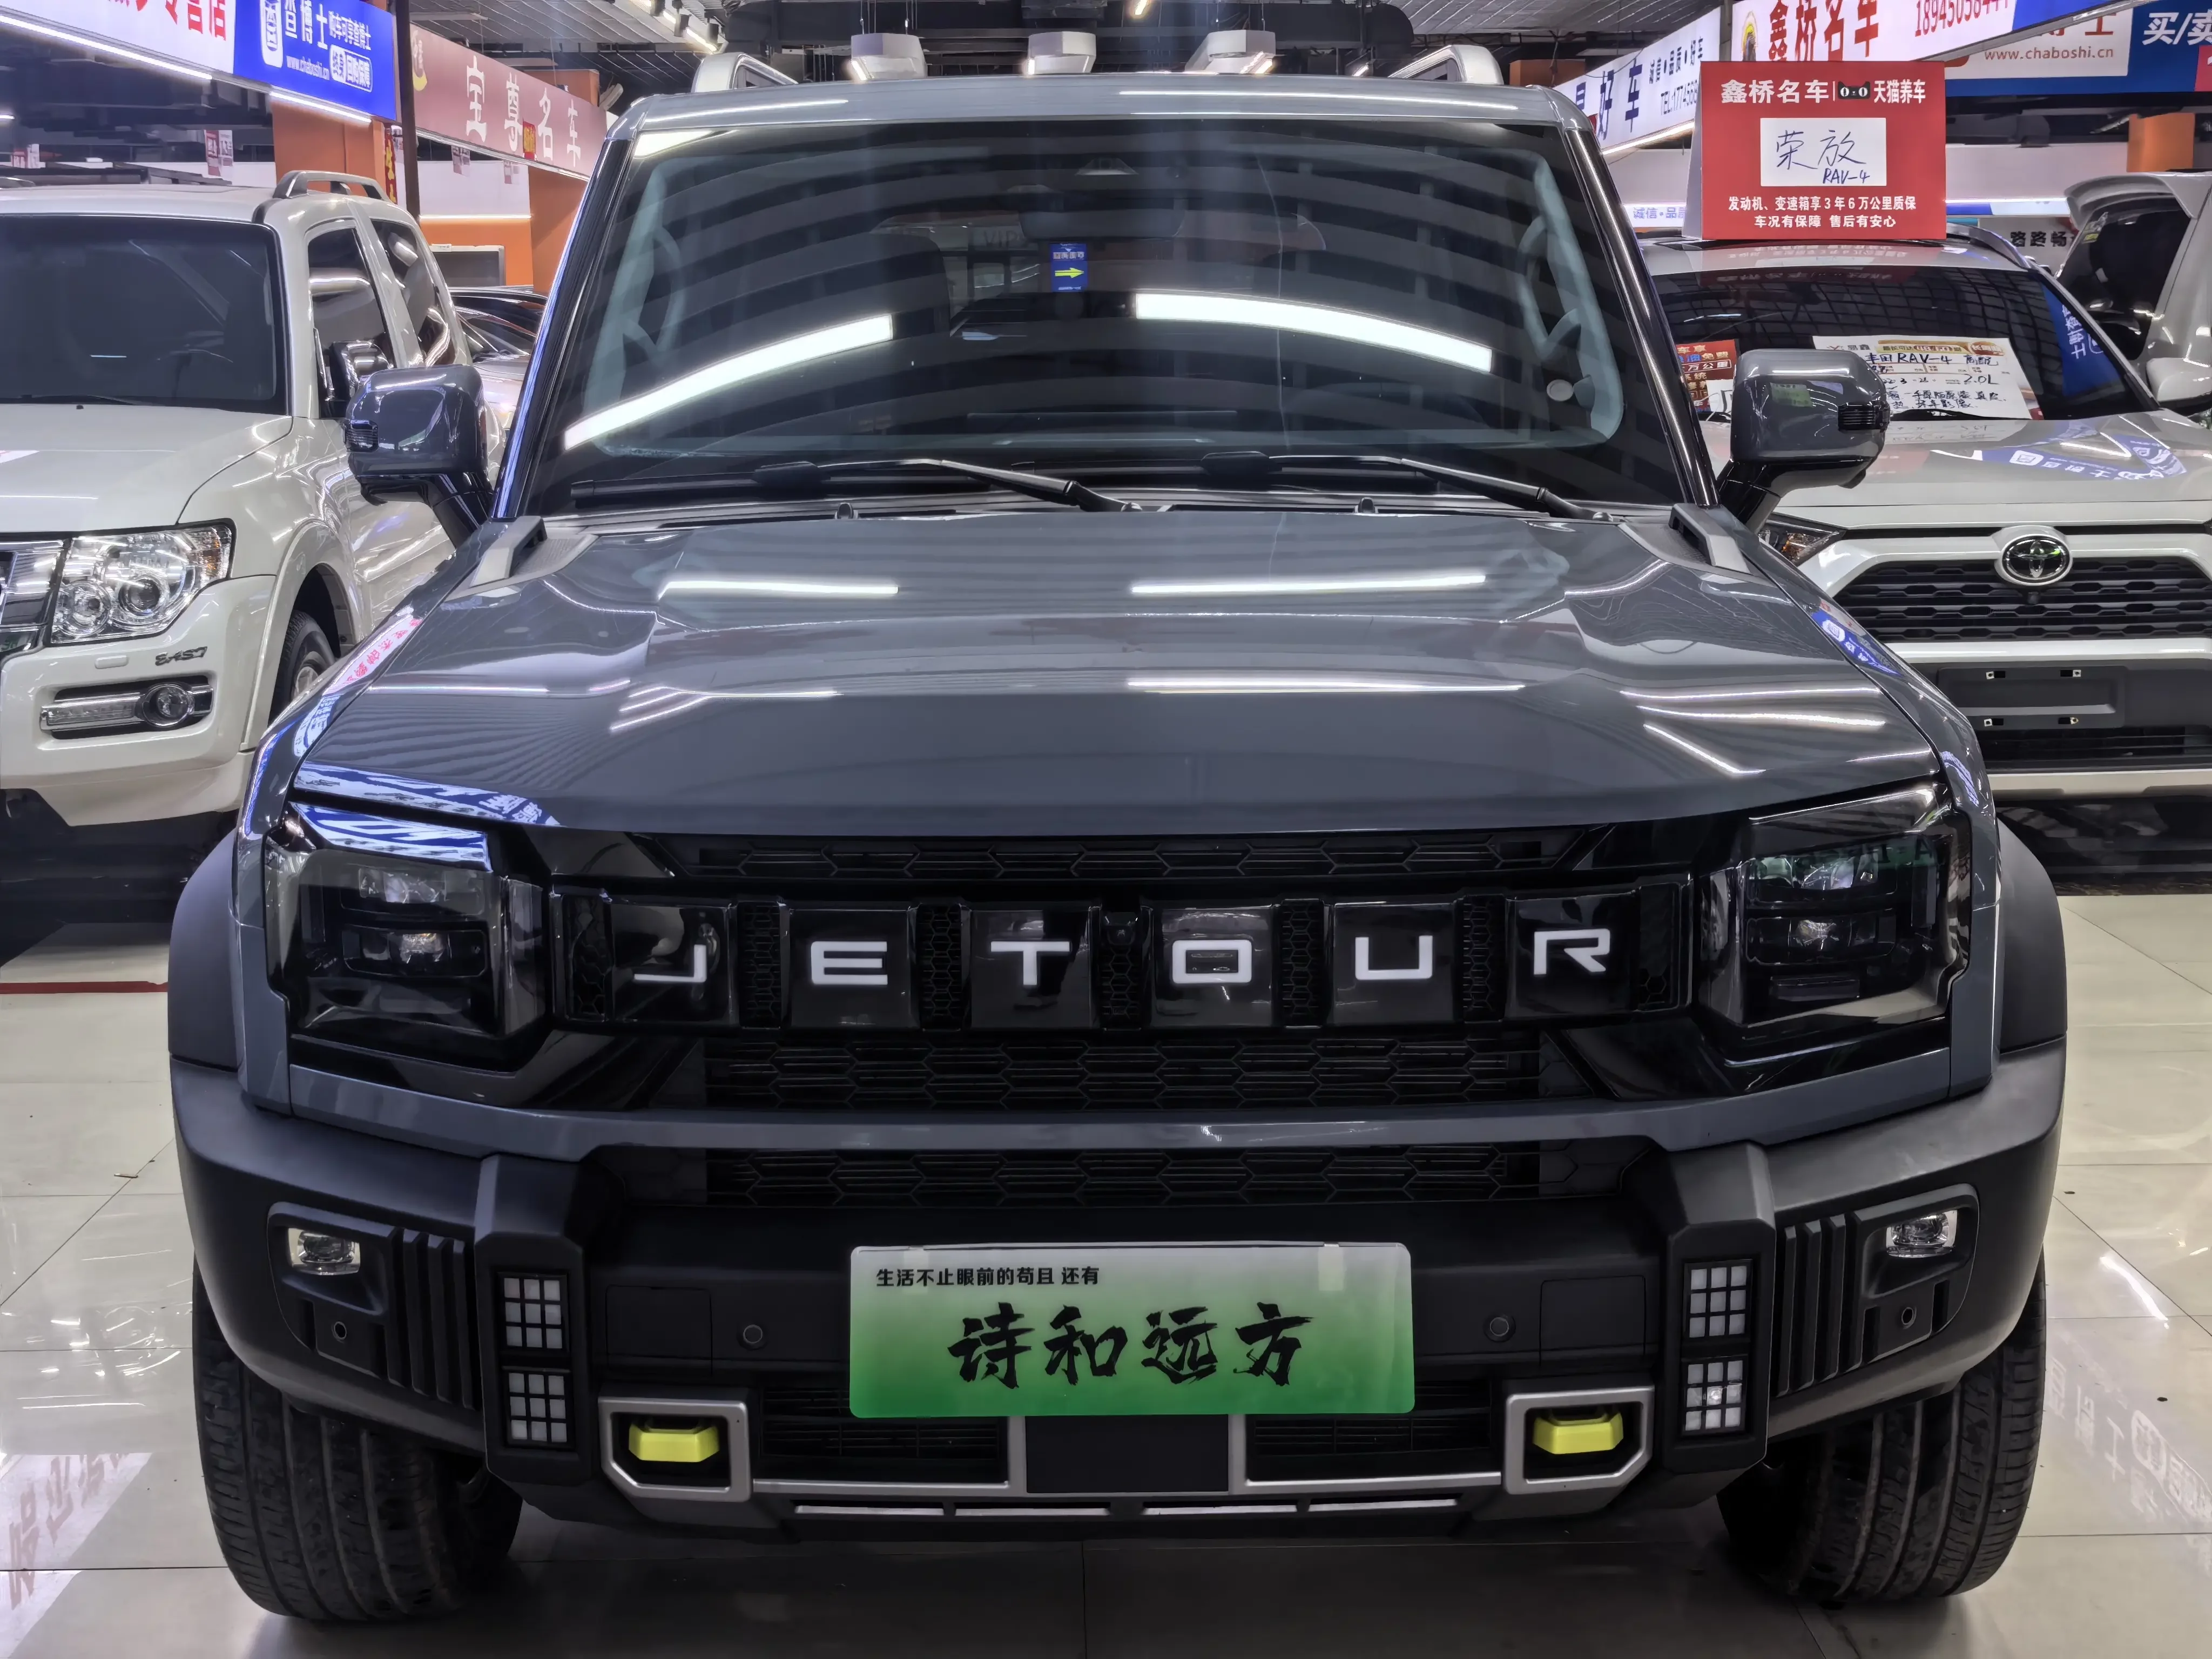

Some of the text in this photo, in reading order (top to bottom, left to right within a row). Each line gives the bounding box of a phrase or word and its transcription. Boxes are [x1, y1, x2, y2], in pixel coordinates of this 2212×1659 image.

[1769, 0, 1878, 61] 鑫桥名车
[1985, 46, 2114, 60] www.chaboshi.cn
[1721, 79, 1926, 104] 鑫桥名车 天猫养车
[1754, 215, 1896, 229] 车况有保障 售后有安心
[634, 928, 1612, 986] JETOUR
[875, 1266, 1099, 1287] 生活不止眼前的苟且 还有
[947, 1301, 1314, 1388] 诗和远方
